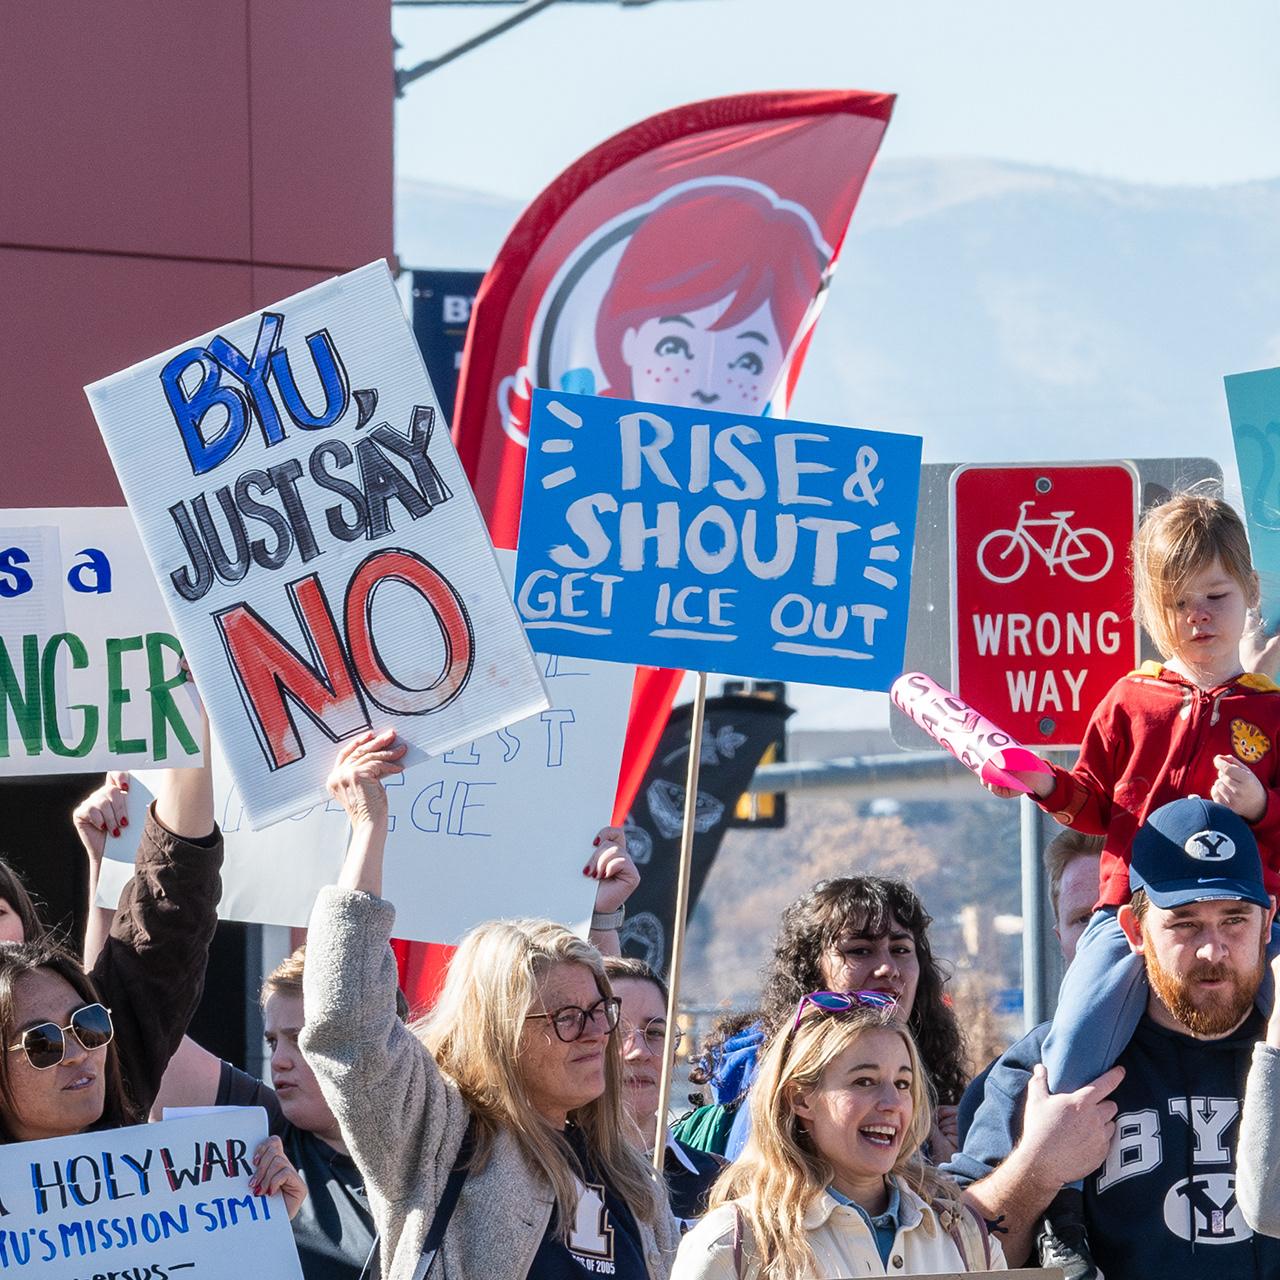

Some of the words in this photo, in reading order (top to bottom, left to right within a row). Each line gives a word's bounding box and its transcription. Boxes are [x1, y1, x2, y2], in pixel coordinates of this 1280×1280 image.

[160, 312, 378, 476] BYU,
[618, 412, 835, 506] RISE
[843, 445, 885, 506] &
[168, 457, 324, 601] JUST
[309, 405, 453, 541] SAY
[547, 493, 861, 587] SHOUT
[67, 548, 111, 594] a
[519, 570, 624, 620] GET
[656, 583, 739, 627] ICE
[771, 593, 888, 646] OUT
[211, 547, 475, 772] NO
[972, 612, 1121, 656] WRONG
[1006, 669, 1088, 713] WAY
[30, 1149, 153, 1214] HOLY
[160, 1138, 253, 1192] WAR
[61, 1207, 190, 1258] MISSION
[596, 1261, 615, 1275] 2005
